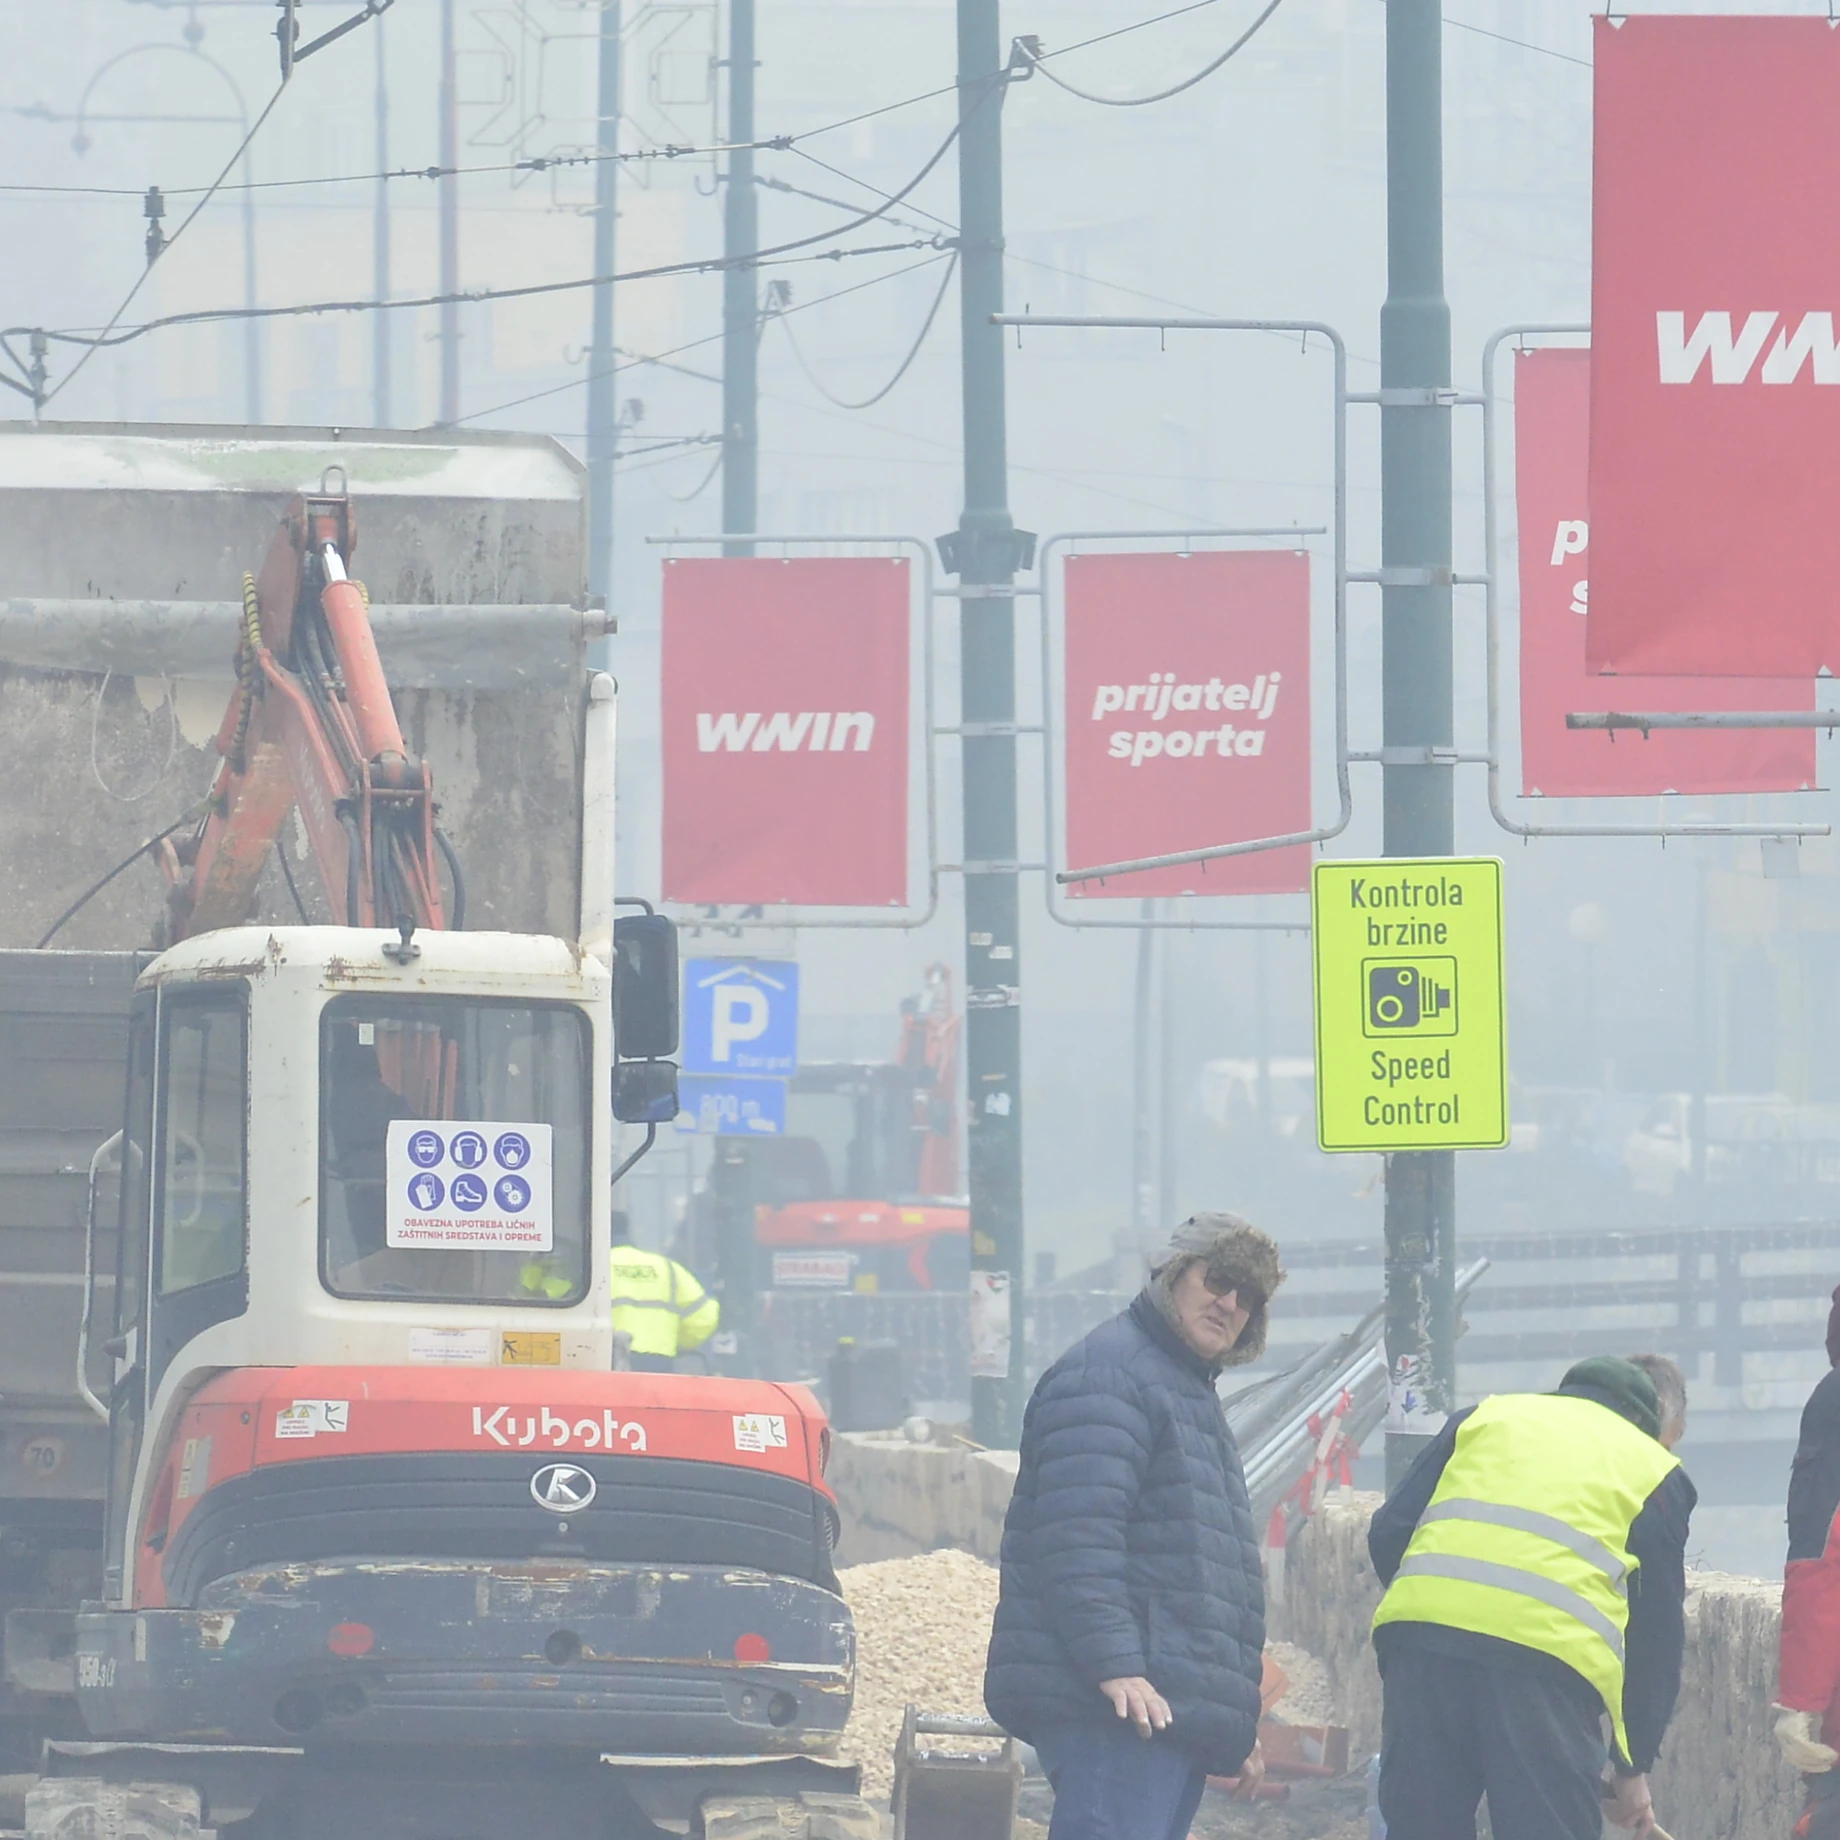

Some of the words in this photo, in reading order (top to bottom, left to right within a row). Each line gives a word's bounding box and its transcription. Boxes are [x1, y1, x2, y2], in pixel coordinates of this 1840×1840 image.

[1092, 671, 1282, 720] prijatelj
[1108, 723, 1265, 767] sporta
[1350, 877, 1463, 908] Kontrola
[1367, 916, 1448, 946] brzine
[711, 984, 769, 1062] P
[1371, 1049, 1451, 1087] Speed
[1364, 1094, 1460, 1125] Control
[398, 1229, 443, 1240] ZAŠTITNIH
[445, 1232, 497, 1241] SREDSTAVA
[505, 1233, 542, 1242] OPREME
[404, 1218, 453, 1228] OBAVEZNA
[455, 1220, 504, 1229] UPOTREBA
[472, 1406, 647, 1451] Kubota
[31, 1446, 55, 1469] 70
